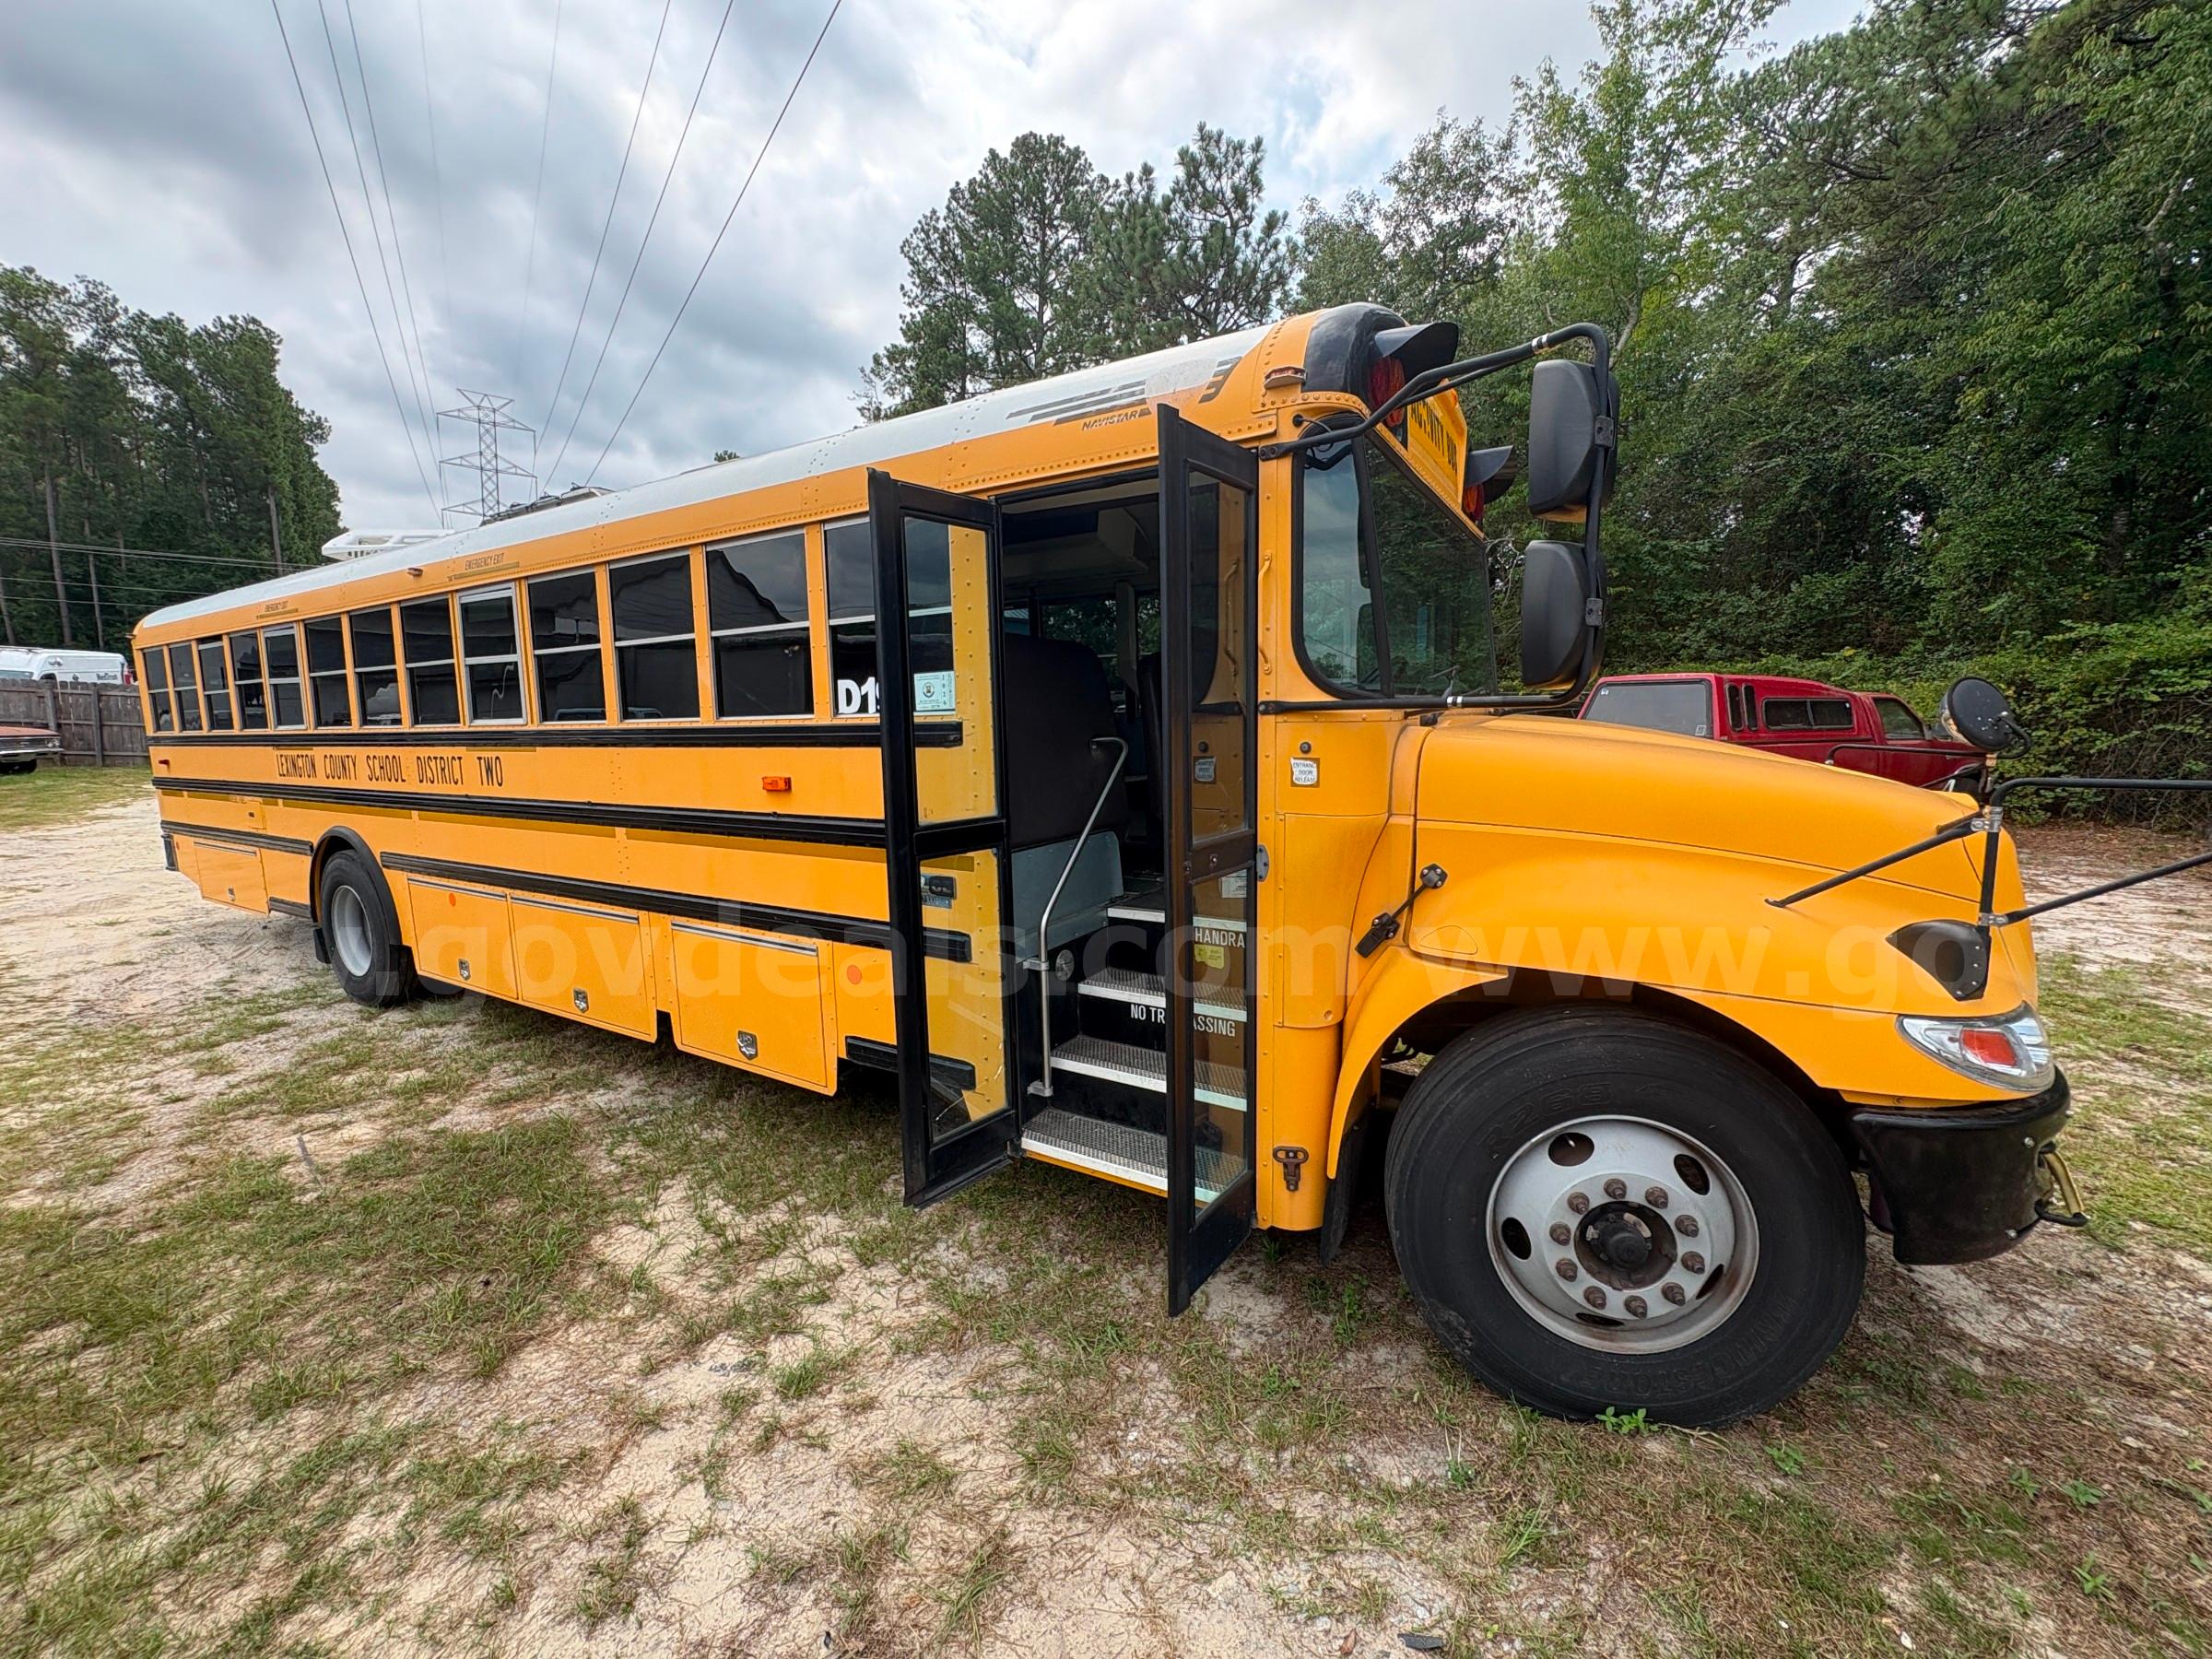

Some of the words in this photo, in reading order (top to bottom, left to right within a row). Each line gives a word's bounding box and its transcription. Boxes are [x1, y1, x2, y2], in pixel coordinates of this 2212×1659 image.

[1082, 409, 1138, 431] NAVISTAR
[465, 555, 493, 571] EMERGENCY
[837, 677, 880, 713] D1
[276, 754, 317, 778] LEXINGTON
[324, 754, 358, 780] COUNTY
[366, 755, 406, 782] SCHOOL
[416, 756, 465, 785] DISTRICT
[477, 756, 503, 787] TWO
[1131, 1004, 1146, 1021] NO
